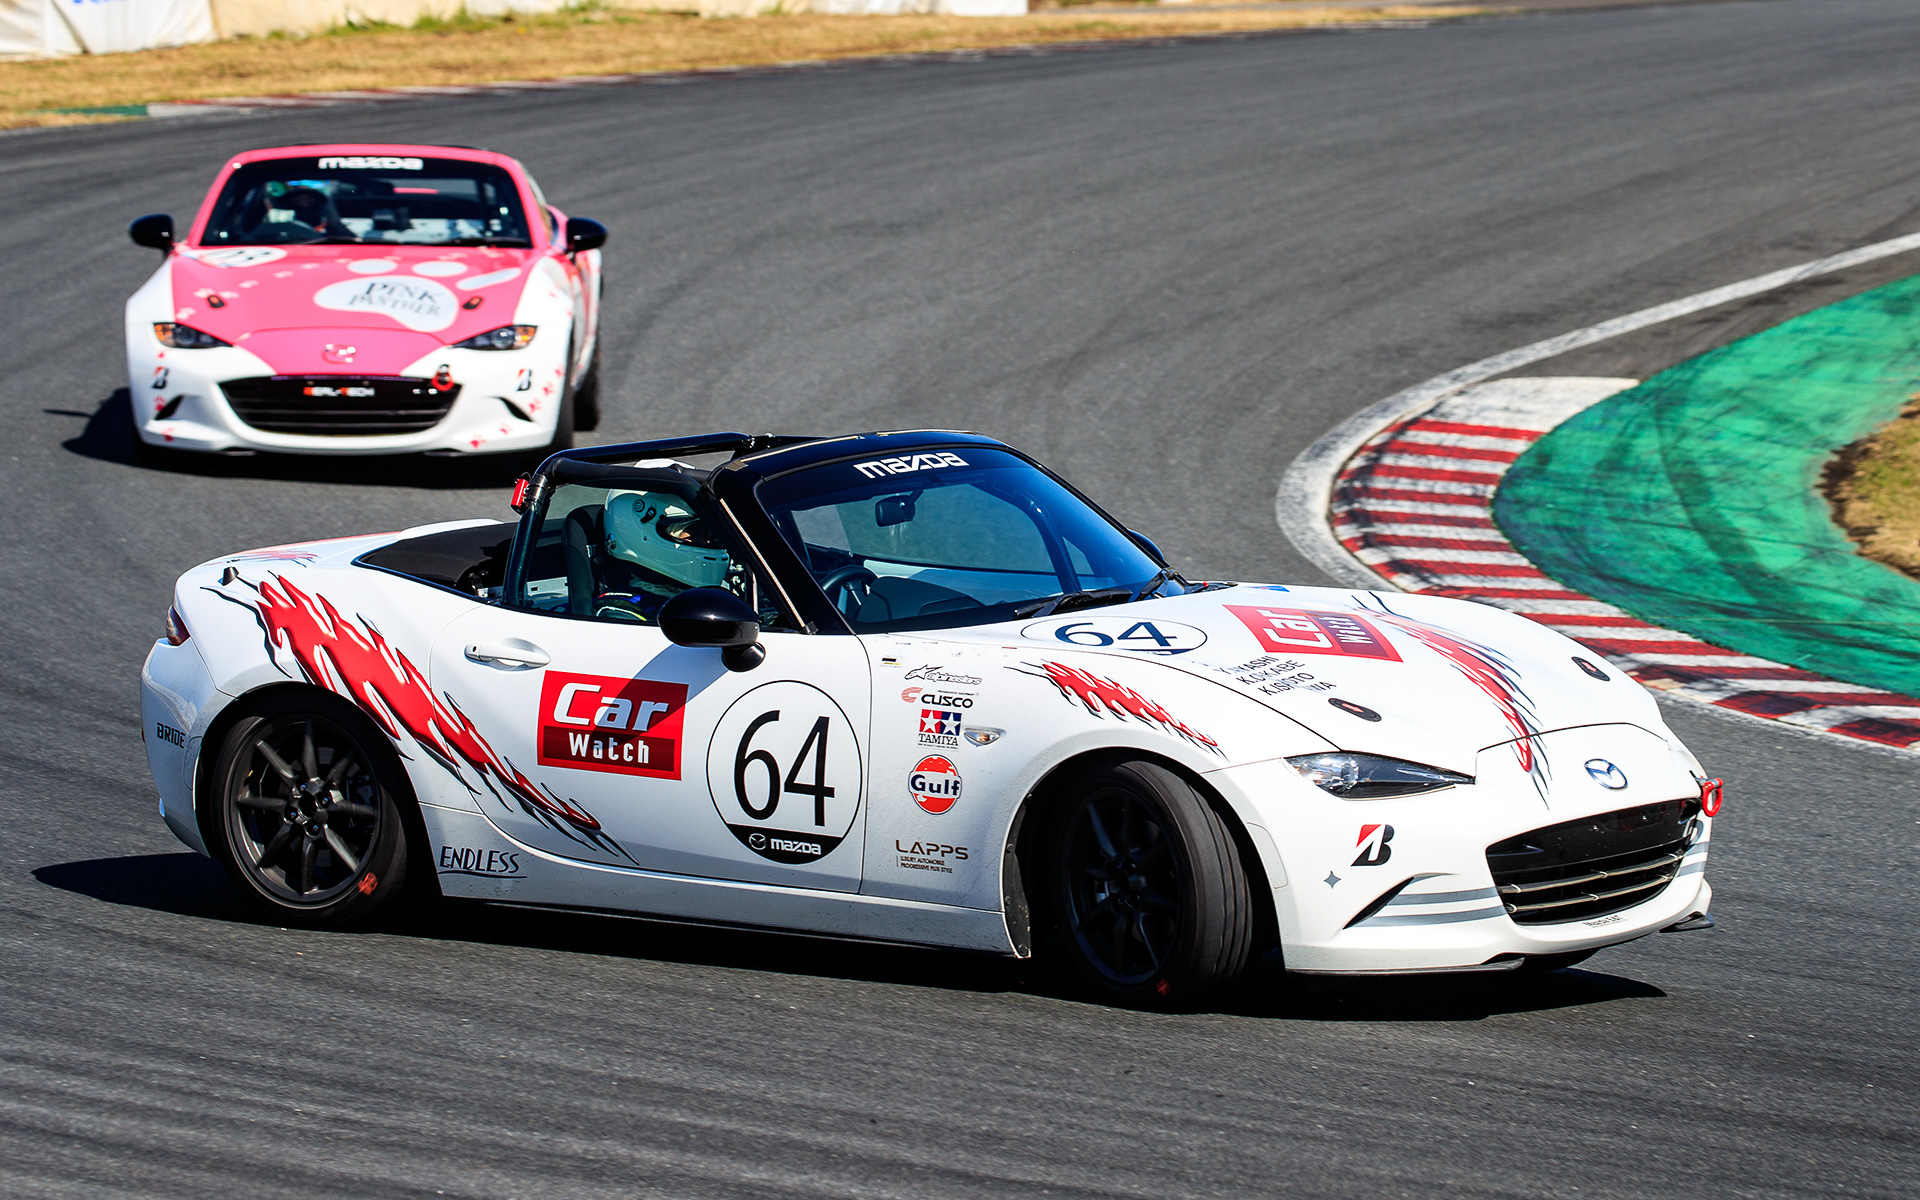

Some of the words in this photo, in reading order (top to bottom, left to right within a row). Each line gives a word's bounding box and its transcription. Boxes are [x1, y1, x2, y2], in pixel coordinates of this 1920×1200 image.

[318, 156, 424, 170] mazda
[365, 282, 437, 303] PINK
[349, 295, 441, 315] PANTHER
[853, 452, 970, 479] mazda
[1055, 622, 1178, 647] 64
[553, 682, 669, 732] Car
[921, 694, 973, 709] CUSCO
[156, 722, 186, 750] BRIDE
[918, 733, 959, 746] TAMIYA
[568, 732, 650, 764] Watch
[733, 709, 835, 827] 64
[910, 774, 960, 795] Gulf
[770, 838, 822, 855] mazda
[895, 839, 969, 860] LAPPS
[439, 845, 520, 873] ENDLESS
